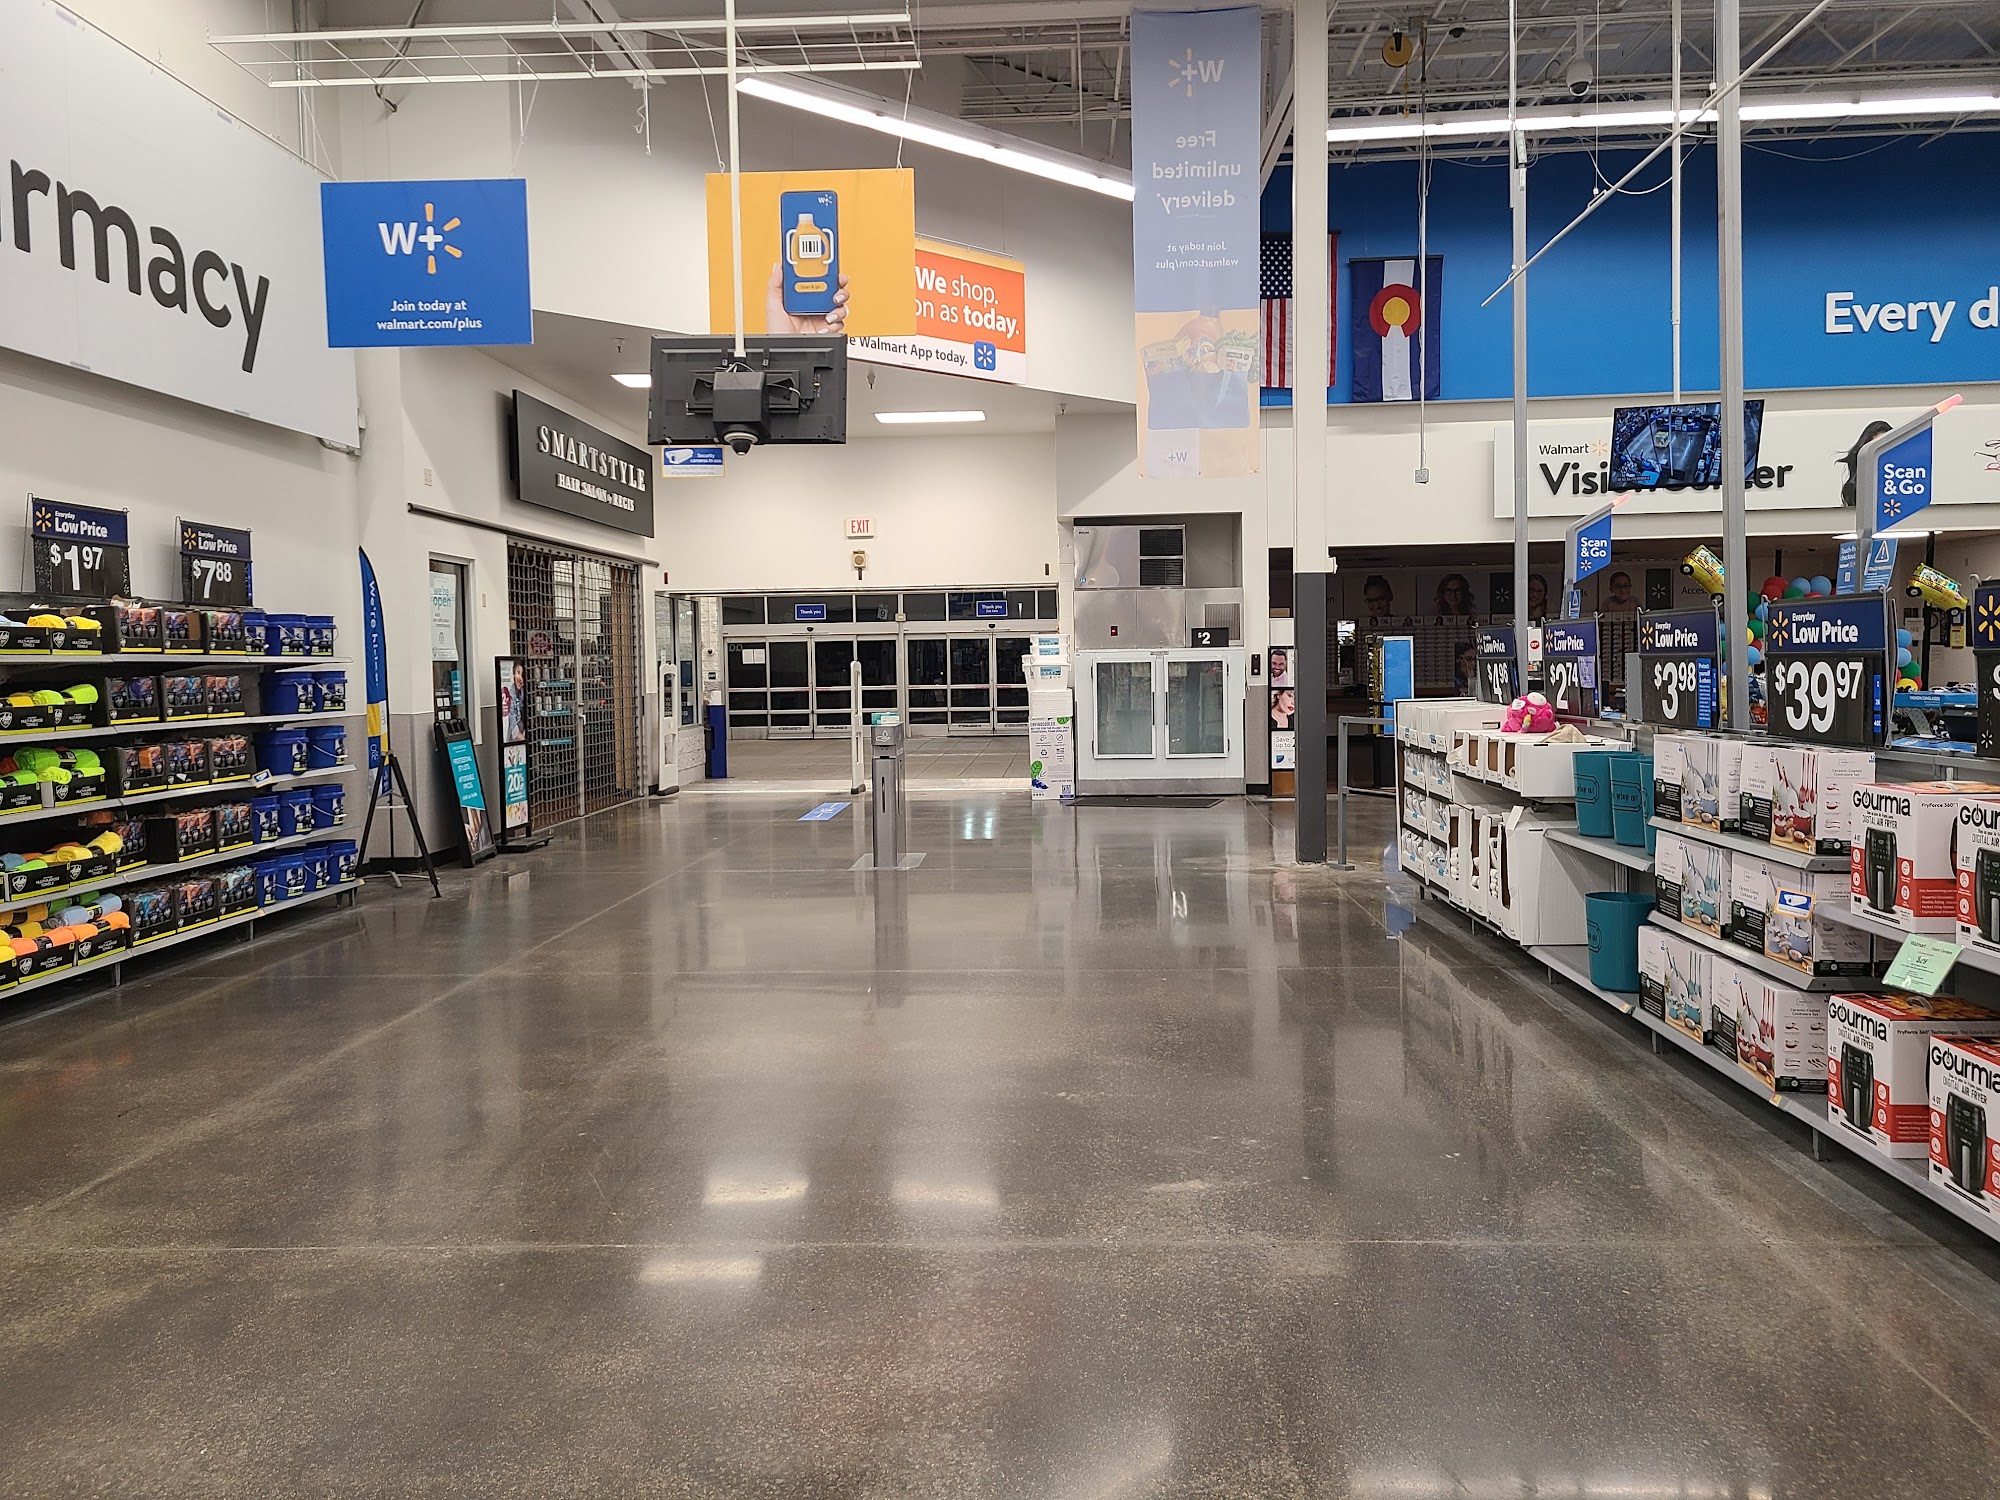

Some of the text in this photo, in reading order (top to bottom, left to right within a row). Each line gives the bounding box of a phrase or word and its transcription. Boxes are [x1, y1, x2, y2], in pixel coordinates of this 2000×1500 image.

[0, 158, 270, 373] rmacy
[915, 265, 999, 308] We shop.
[390, 299, 467, 314] Join today at
[376, 316, 483, 332] walmart.com/plus
[915, 298, 1020, 340] on as today.
[1825, 291, 1956, 343] Every
[859, 336, 908, 355] Walmart
[910, 343, 933, 361] App
[935, 348, 968, 367] today.
[1539, 442, 1589, 456] Walmart
[538, 425, 646, 492] SMARTSTYLE
[1883, 463, 1926, 480] Scan
[556, 472, 581, 493] HAIR
[580, 481, 608, 503] SALON
[611, 492, 635, 512] REGIS
[55, 510, 76, 521] Everyday
[54, 517, 108, 538] Low Price
[851, 519, 870, 534] EXIT
[198, 537, 238, 554] Low Price
[1580, 536, 1608, 548] Scan
[432, 596, 452, 610] open
[1791, 611, 1816, 623] Everyday
[1197, 631, 1211, 645] $2
[1655, 628, 1698, 648] Low Price
[1792, 619, 1859, 644] Low Price
[1483, 639, 1506, 653] Low Price
[1554, 635, 1584, 651] Low Price
[1852, 789, 1910, 816] Gourmia
[1876, 817, 1885, 826] AIR
[1884, 818, 1898, 830] FRYER
[1971, 833, 1990, 846] DIGITAL
[1829, 1002, 1888, 1042] Gourmia
[1860, 1038, 1875, 1051] FRYER
[1961, 1084, 1970, 1097] AIR
[1971, 1087, 1988, 1105] FRYER
